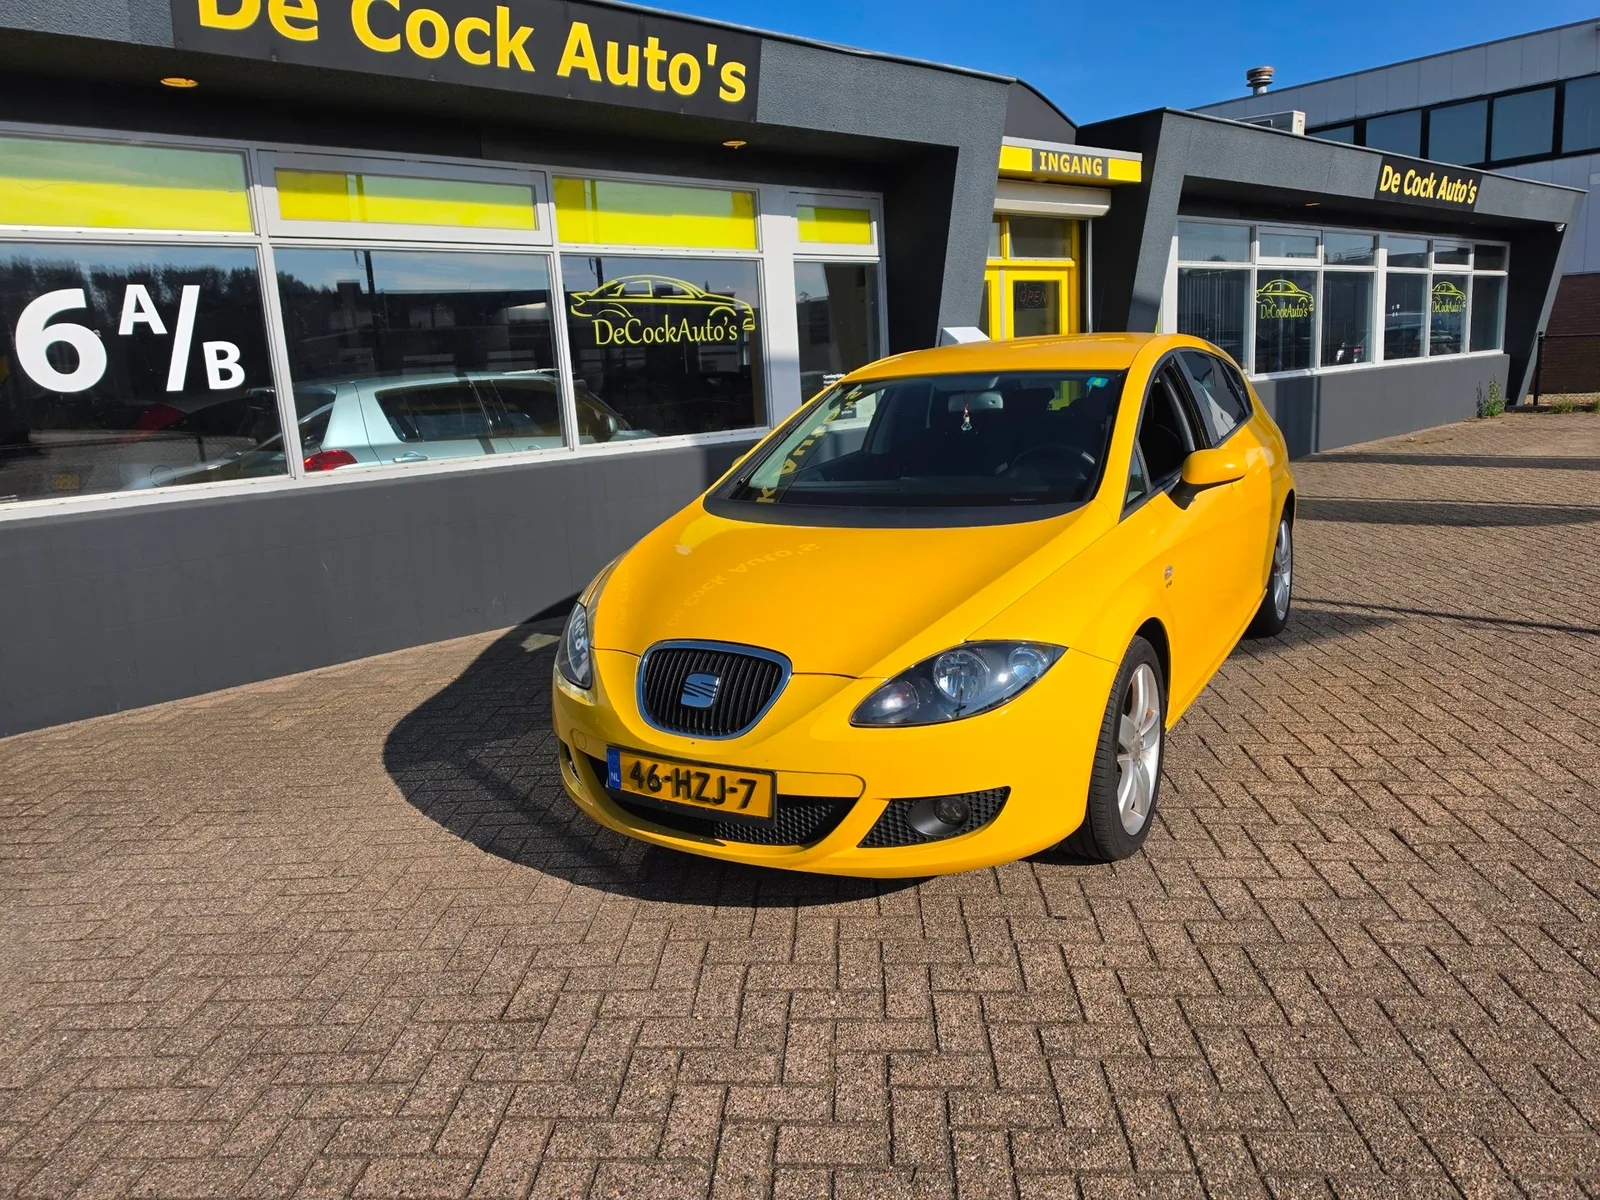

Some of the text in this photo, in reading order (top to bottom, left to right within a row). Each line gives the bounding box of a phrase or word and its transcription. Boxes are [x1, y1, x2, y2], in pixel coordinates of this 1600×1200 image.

[351, 0, 535, 72] Cock
[556, 21, 747, 103] Auto's
[1039, 152, 1103, 176] INGANG
[1379, 165, 1478, 204] De Cock Auto's
[610, 771, 620, 783] NL
[628, 760, 758, 810] 46-HZJ-7
